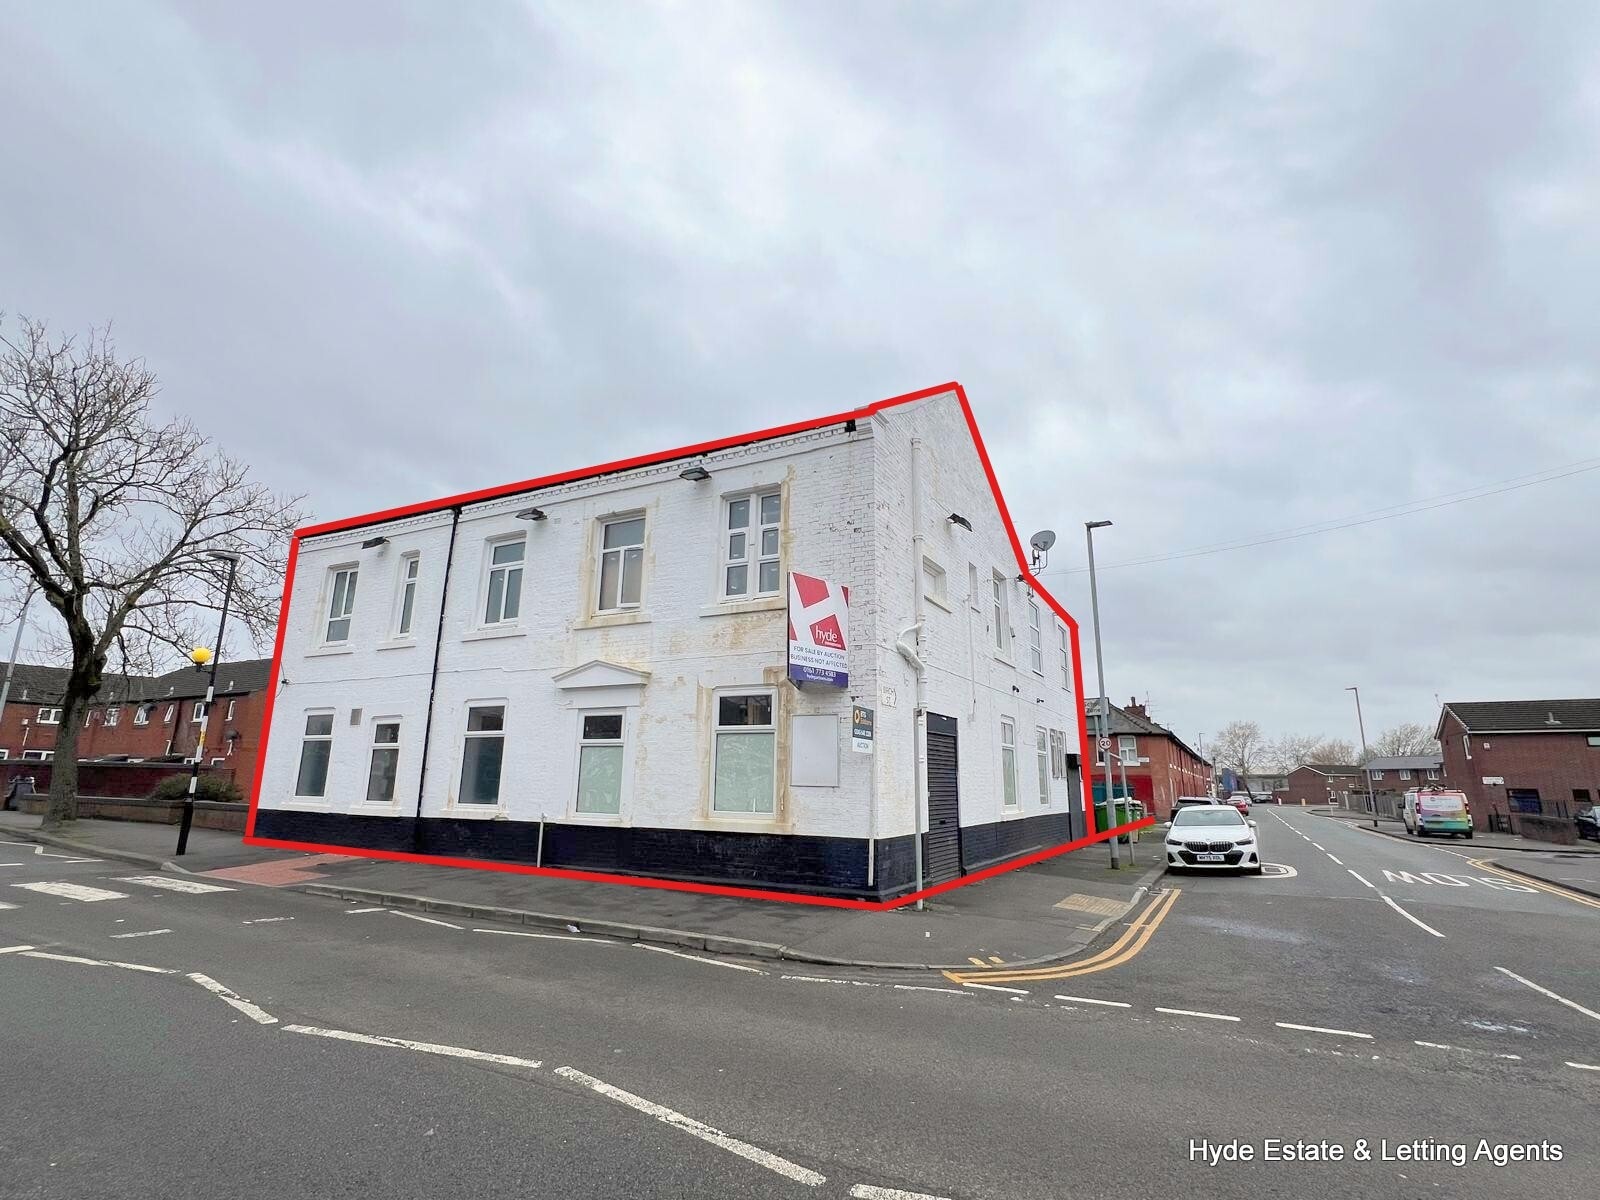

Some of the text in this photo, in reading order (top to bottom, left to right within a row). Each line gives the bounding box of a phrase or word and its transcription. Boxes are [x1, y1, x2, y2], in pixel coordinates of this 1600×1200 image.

[815, 625, 838, 644] hyde
[791, 653, 814, 663] BUSINESS
[826, 660, 848, 669] AFFECTED
[805, 647, 816, 655] SALE
[824, 651, 845, 660] AUCTION
[1381, 869, 1540, 893] SLOW
